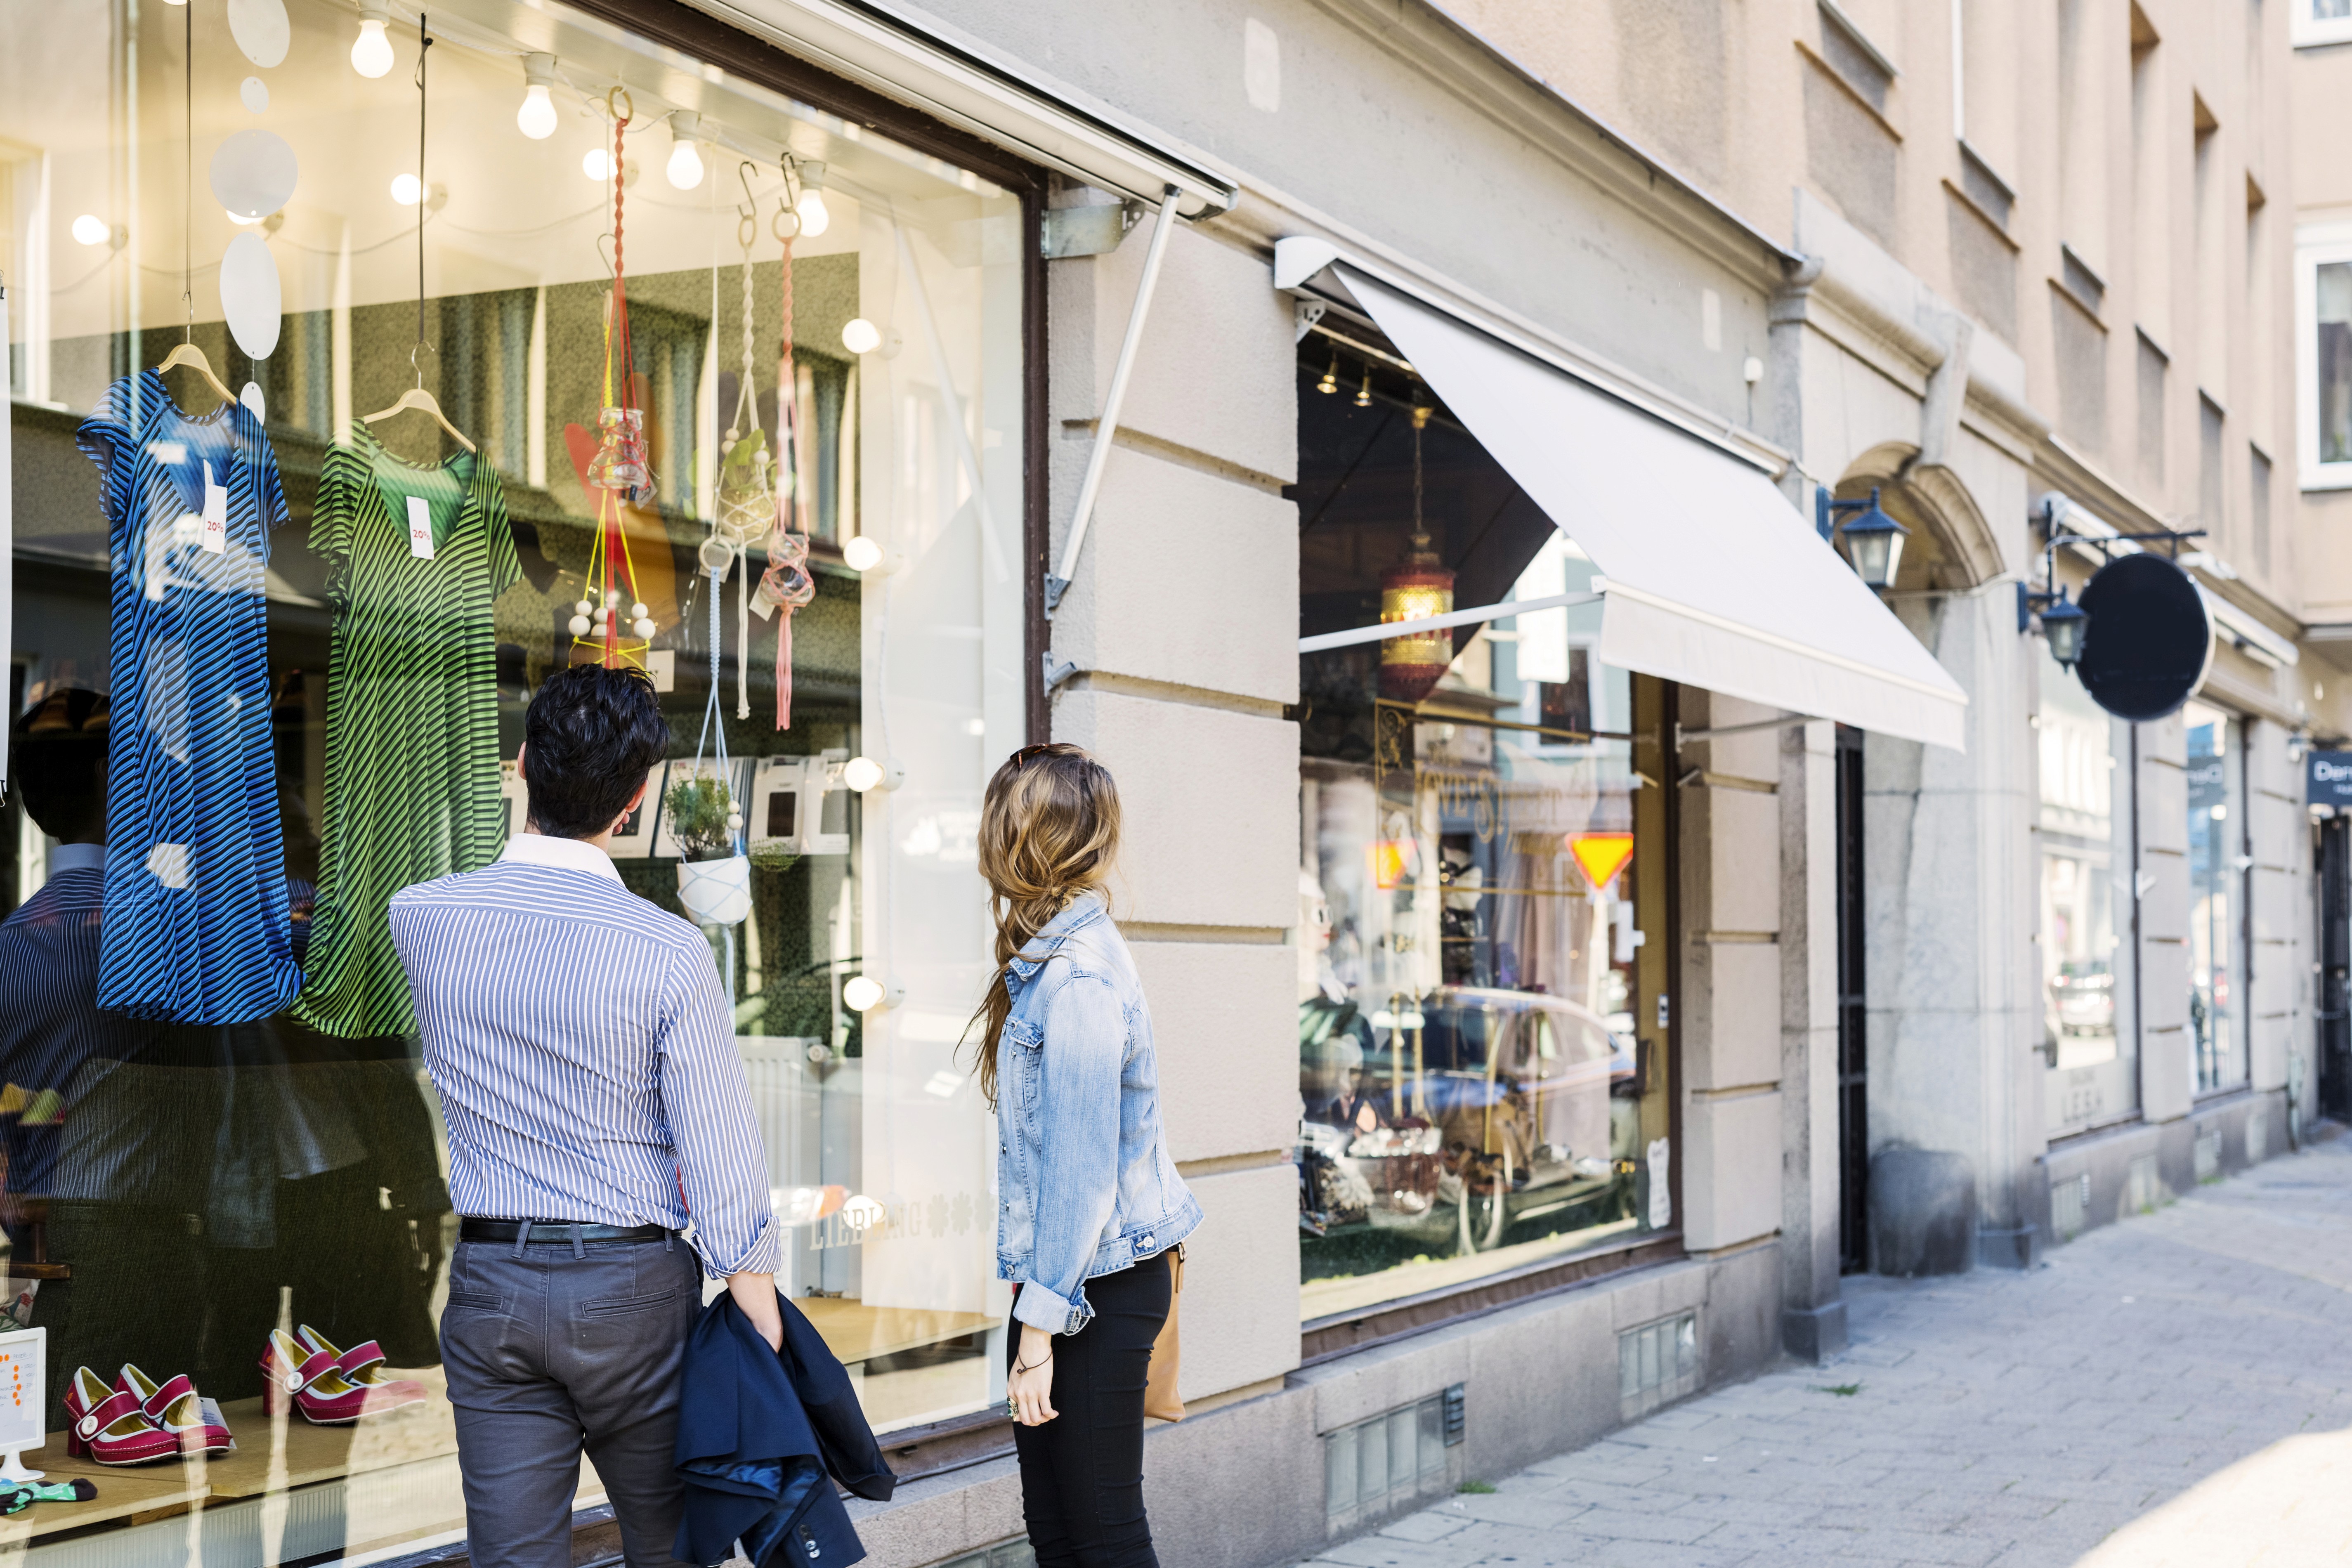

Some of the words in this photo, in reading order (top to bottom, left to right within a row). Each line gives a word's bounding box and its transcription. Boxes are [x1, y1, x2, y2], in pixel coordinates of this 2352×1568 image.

[207, 521, 223, 532] 20%
[413, 529, 430, 540] 20%
[810, 1200, 923, 1251] LIEBLING
